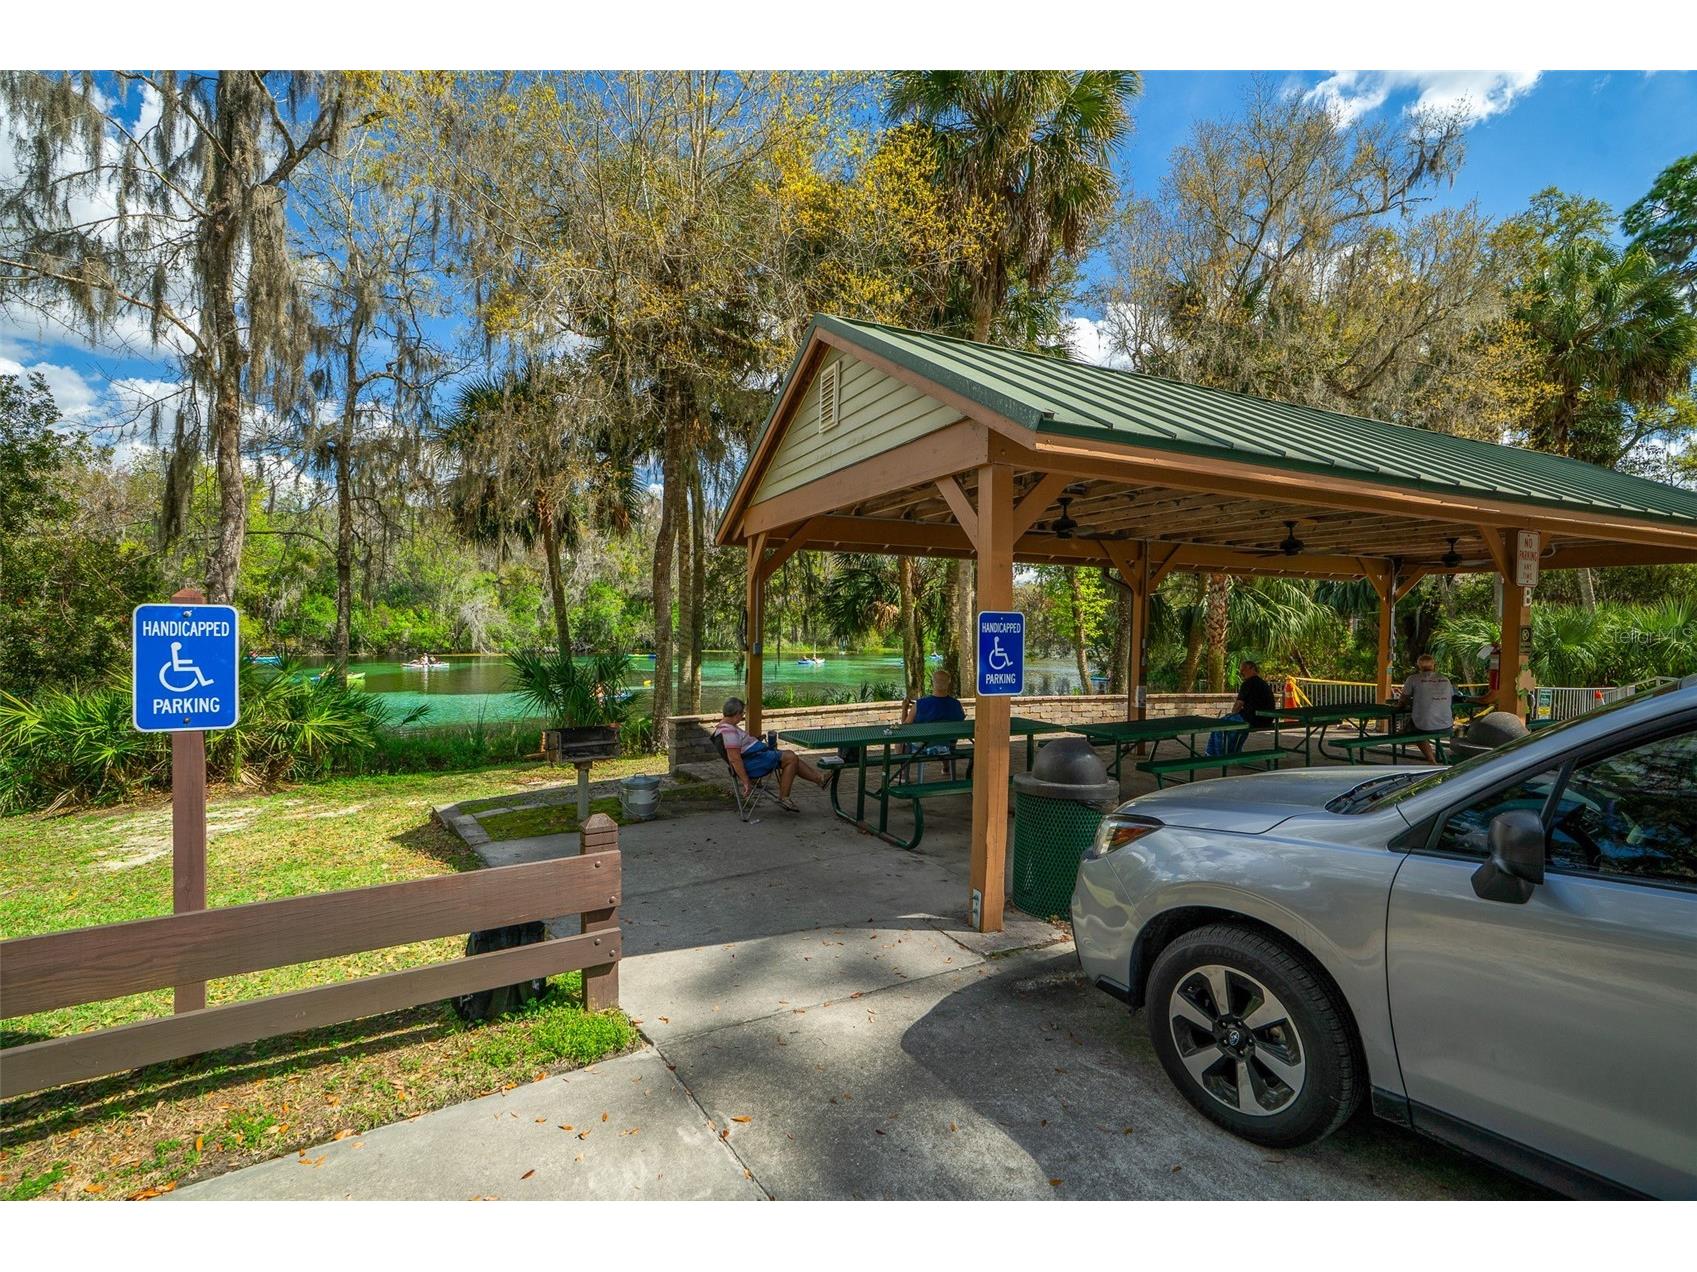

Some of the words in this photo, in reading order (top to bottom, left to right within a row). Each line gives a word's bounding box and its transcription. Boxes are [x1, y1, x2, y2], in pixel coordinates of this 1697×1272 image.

[1524, 537, 1534, 549] NO
[1519, 551, 1539, 560] PARKING
[1523, 563, 1533, 571] ANY
[1523, 586, 1533, 608] B
[142, 620, 230, 637] HANDICAPPED
[981, 622, 1022, 634] HANDICAPPED
[985, 673, 1017, 685] PARKING
[153, 697, 220, 715] PARKING
